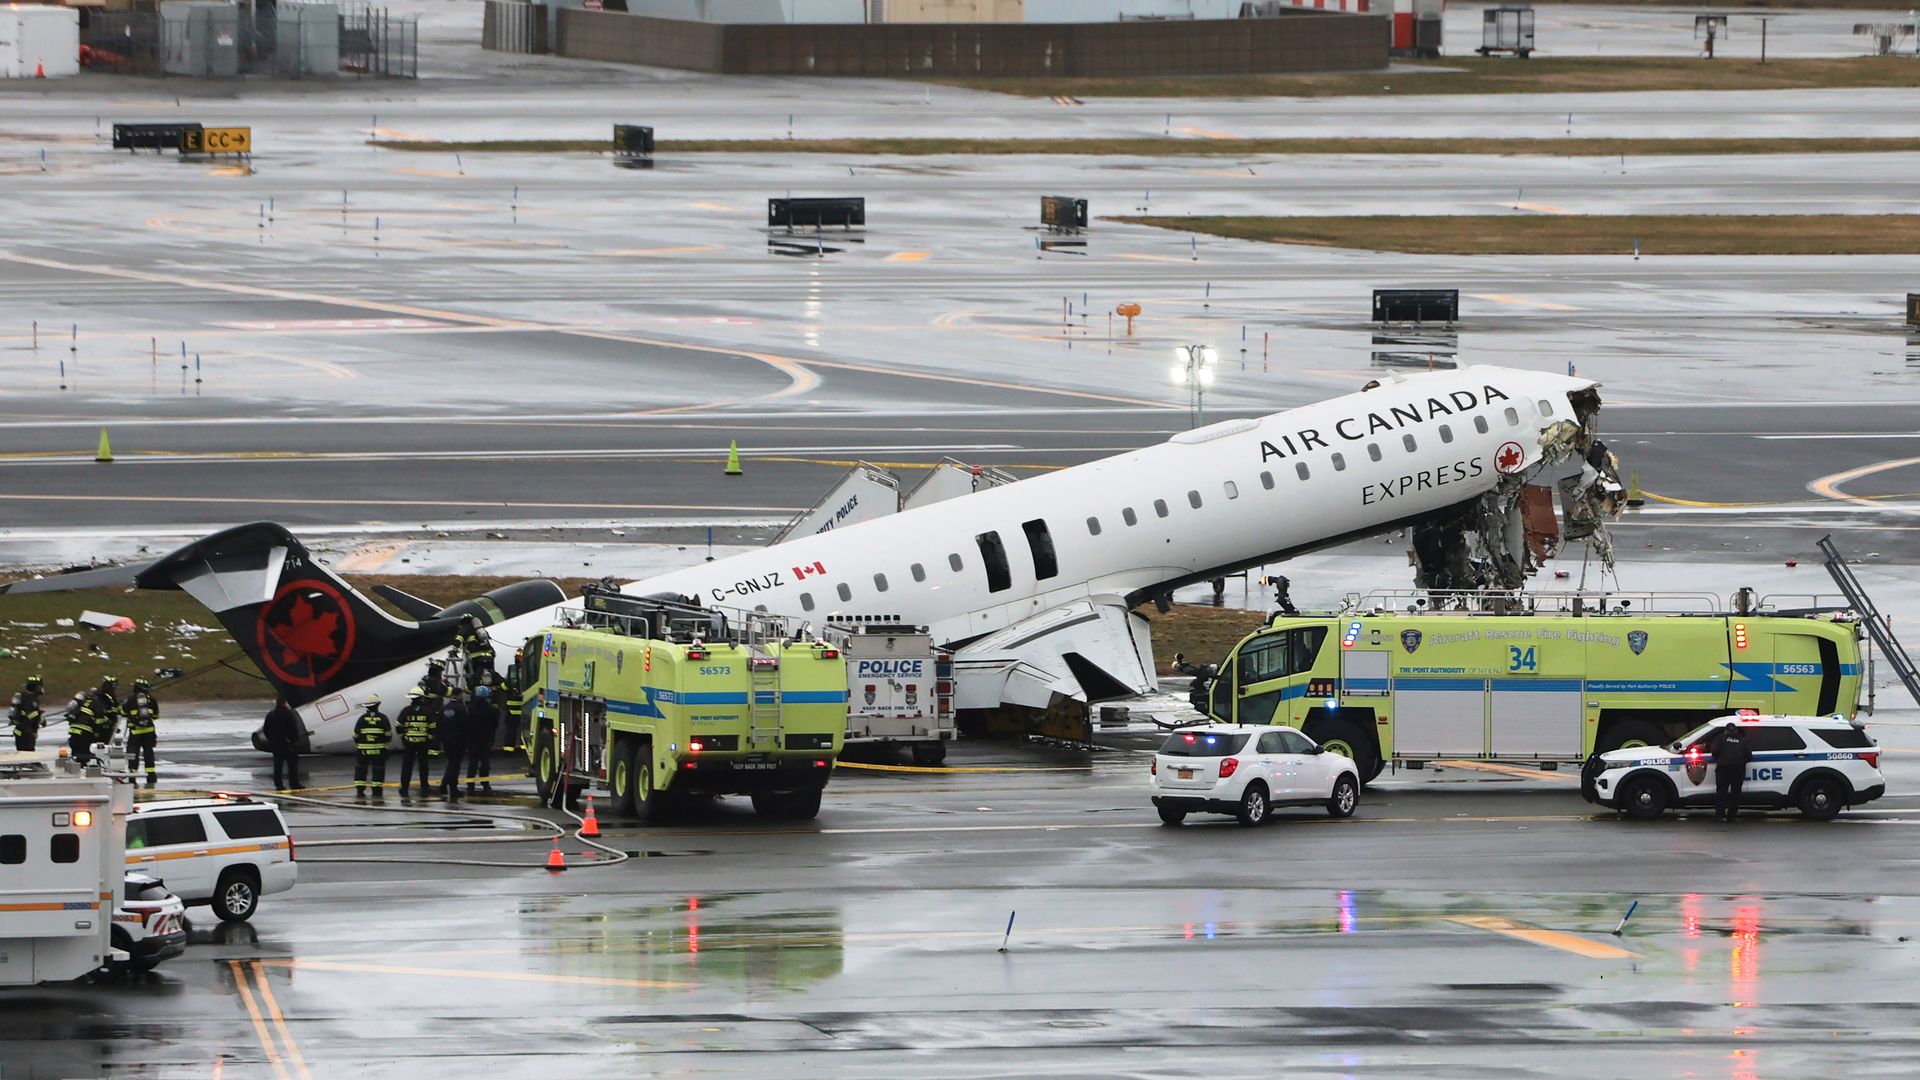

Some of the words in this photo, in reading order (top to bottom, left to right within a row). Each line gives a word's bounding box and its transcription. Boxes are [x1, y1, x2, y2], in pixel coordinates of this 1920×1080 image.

[189, 133, 198, 148] E
[208, 132, 230, 148] CC
[1260, 429, 1329, 463] AIR
[1335, 385, 1510, 441] CANADA
[1362, 457, 1483, 506] EXPRESS
[836, 494, 859, 523] POLICE
[711, 572, 785, 602] C-GNJZ
[1430, 629, 1480, 645] Aircraft
[1486, 629, 1531, 640] Rescue
[1537, 628, 1561, 640] Fire
[1567, 630, 1621, 647] Fighting
[859, 660, 923, 673] POLICE
[1509, 646, 1537, 672] 34
[700, 666, 731, 675] 56573
[1783, 664, 1815, 674] 56563
[1640, 758, 1671, 766] POLICE
